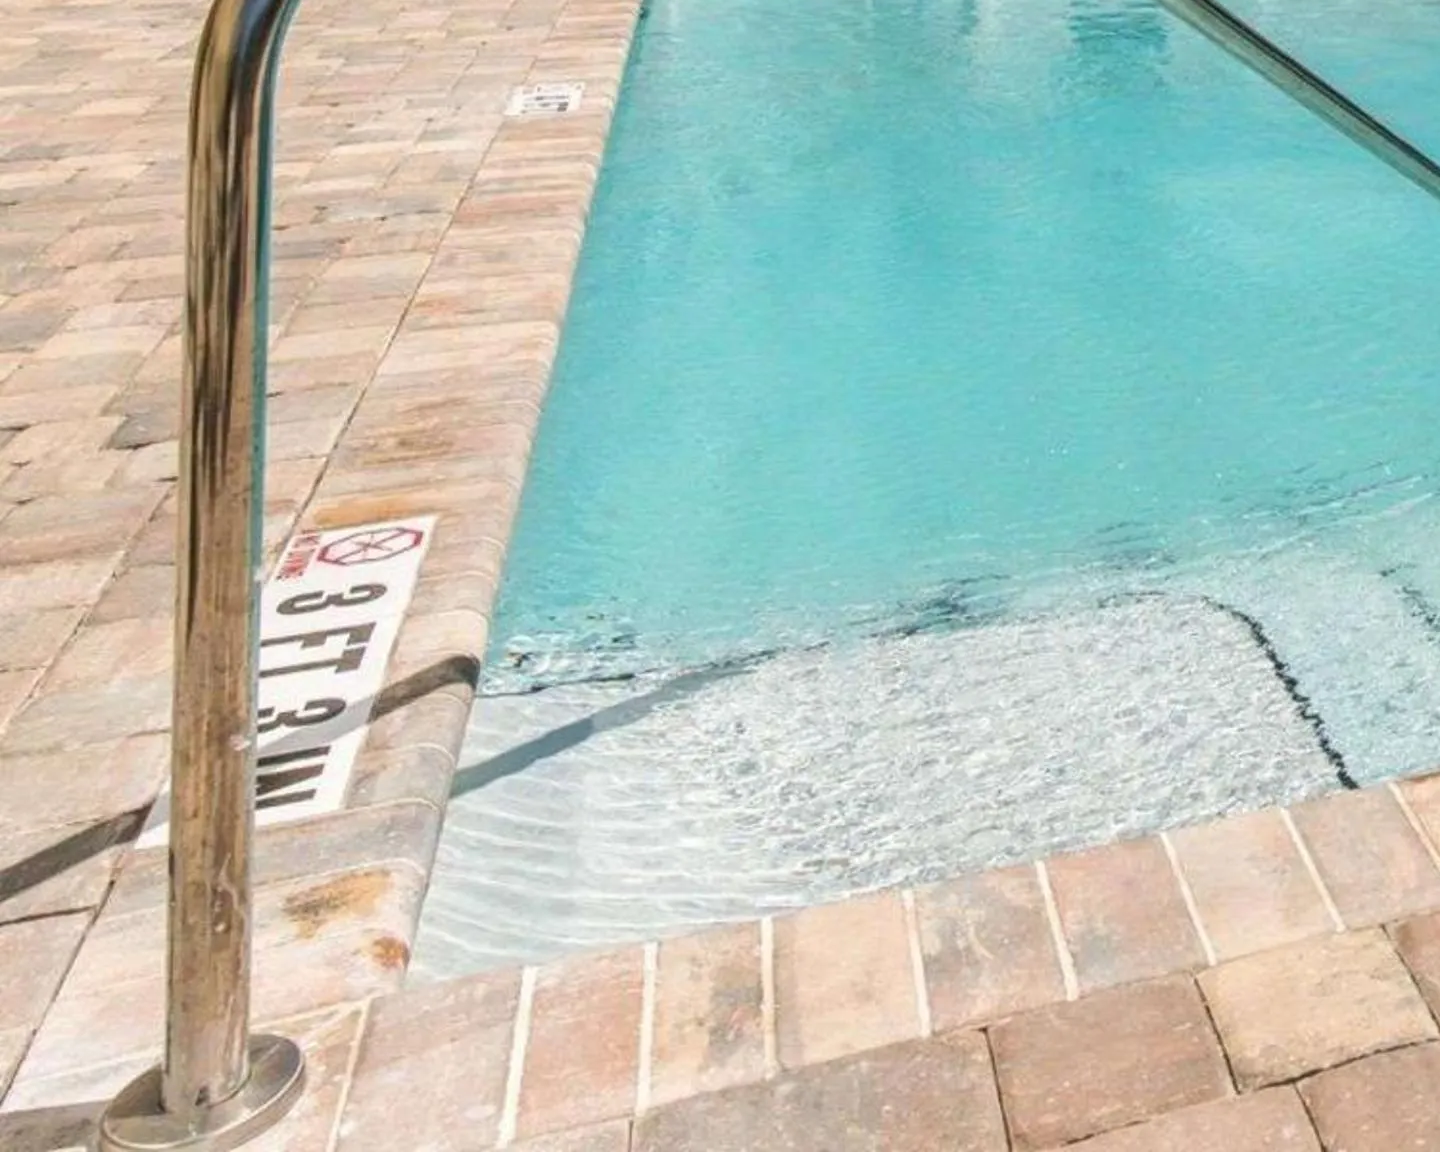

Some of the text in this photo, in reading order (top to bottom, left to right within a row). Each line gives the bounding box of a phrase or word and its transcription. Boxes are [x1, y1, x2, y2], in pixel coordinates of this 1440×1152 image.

[276, 583, 388, 615] 3
[259, 622, 377, 678] FT
[257, 698, 346, 734] 3
